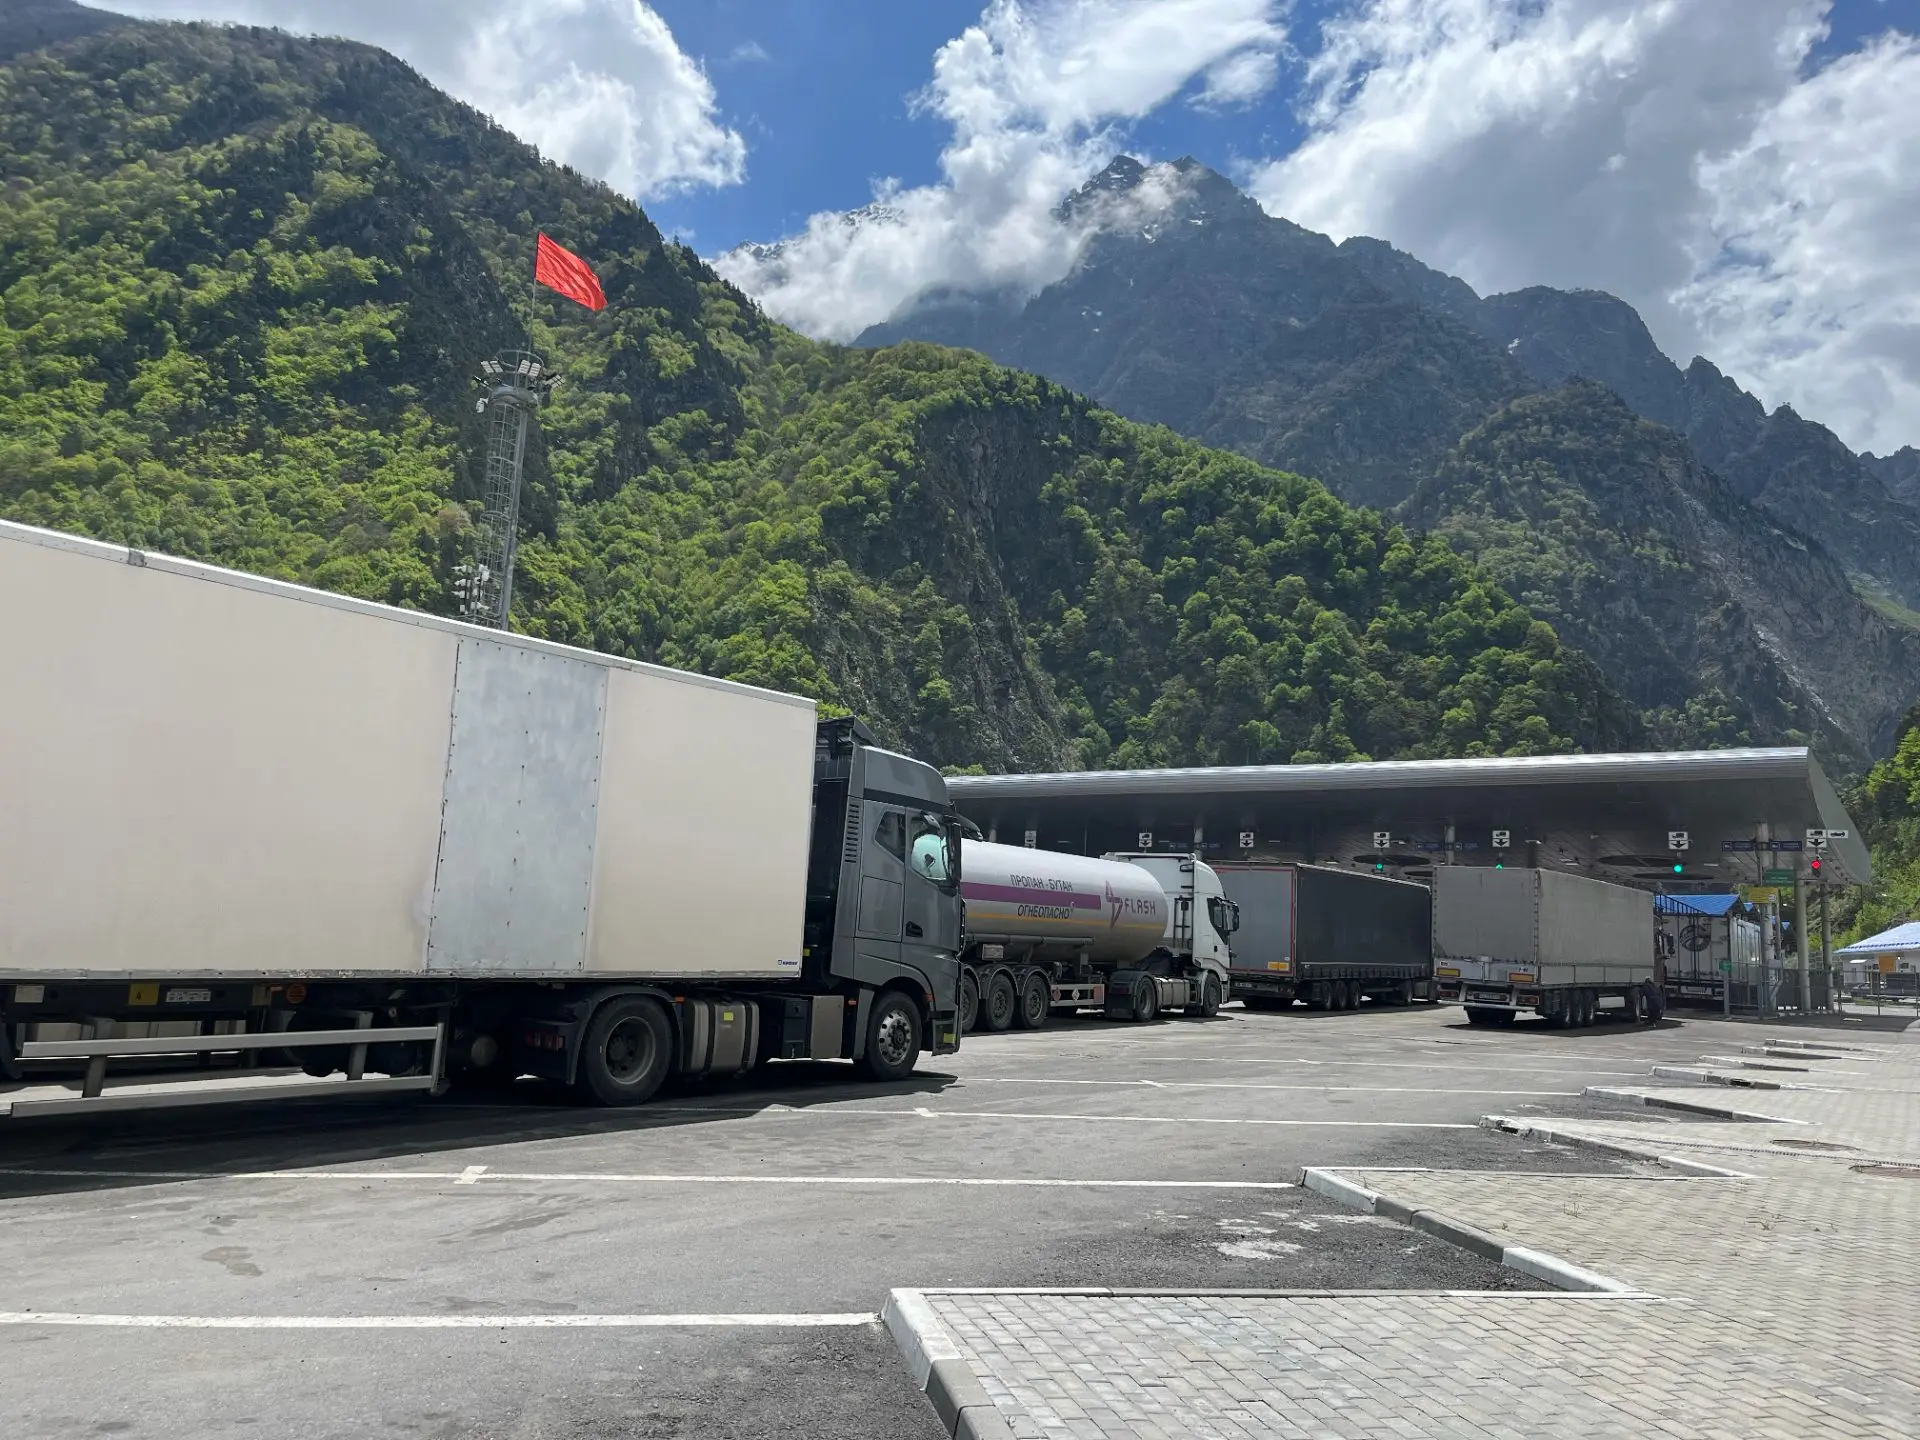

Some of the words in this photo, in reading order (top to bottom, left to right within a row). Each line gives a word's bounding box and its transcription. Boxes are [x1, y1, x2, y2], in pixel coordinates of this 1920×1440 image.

[1010, 874, 1044, 888] ПРОПАН
[1048, 878, 1073, 891] БУТАН
[1124, 897, 1156, 916] FLASH
